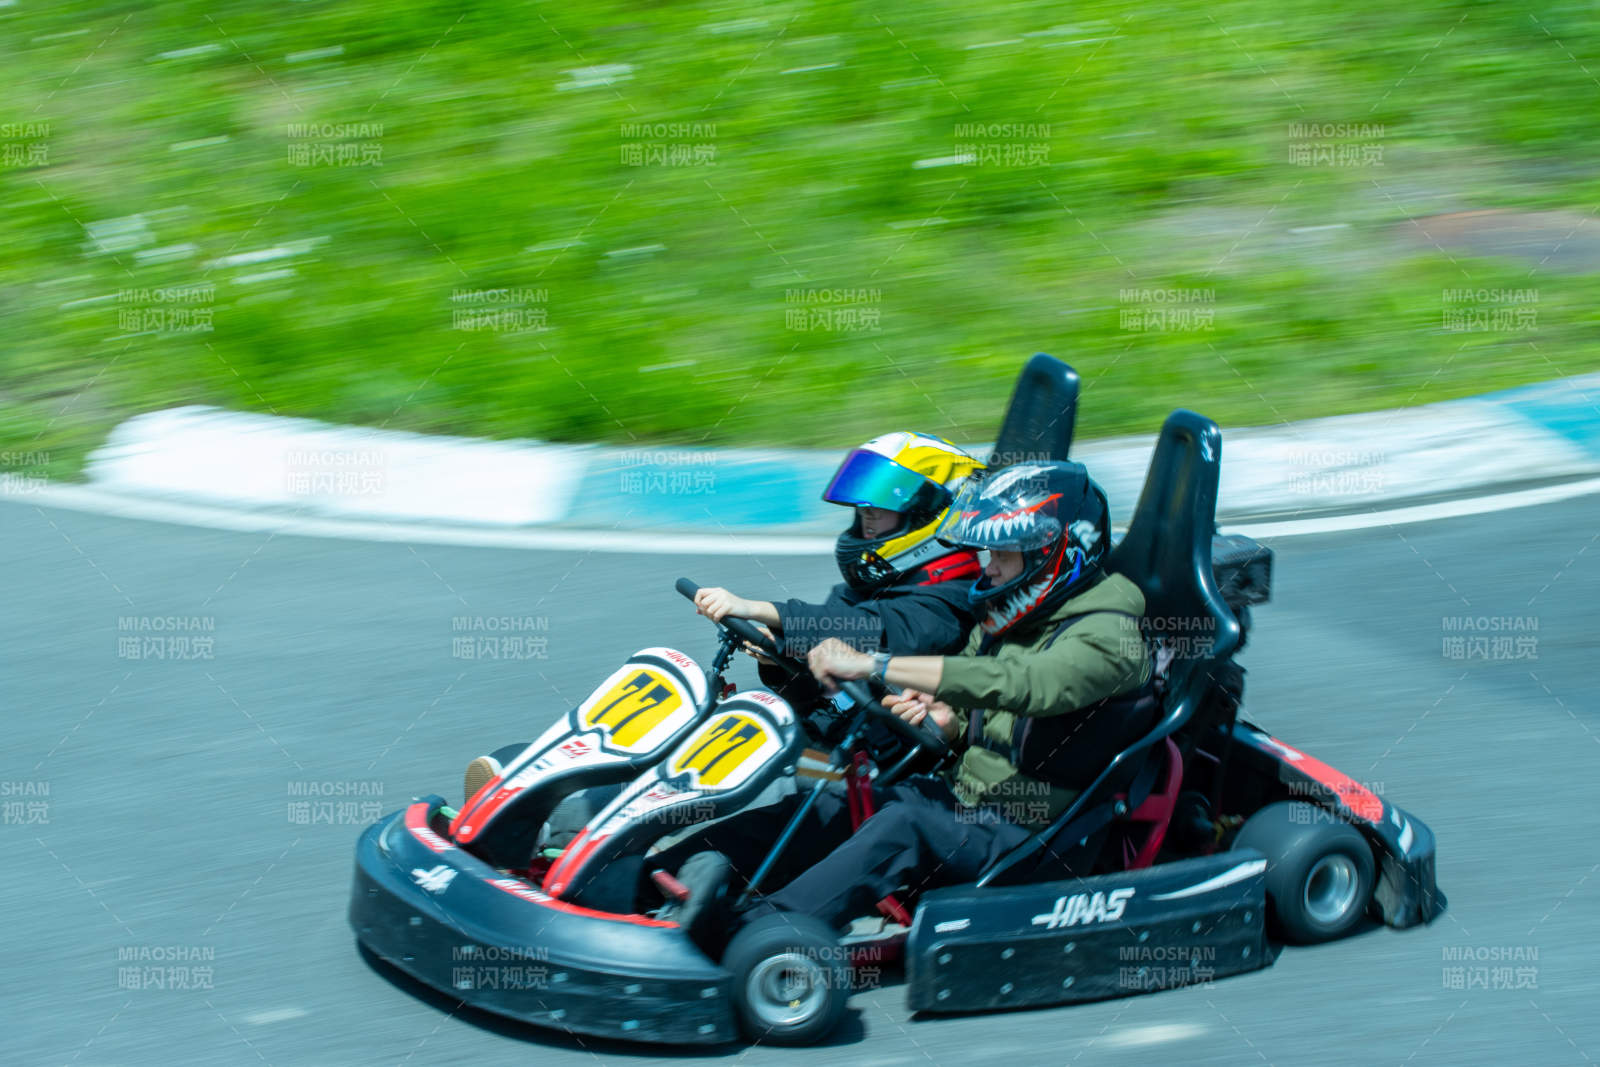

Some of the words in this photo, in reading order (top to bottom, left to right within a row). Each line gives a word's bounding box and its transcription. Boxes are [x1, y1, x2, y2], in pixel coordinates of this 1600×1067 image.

[590, 671, 673, 736] 77
[680, 716, 762, 777] 77
[1031, 887, 1136, 929] HAAS
